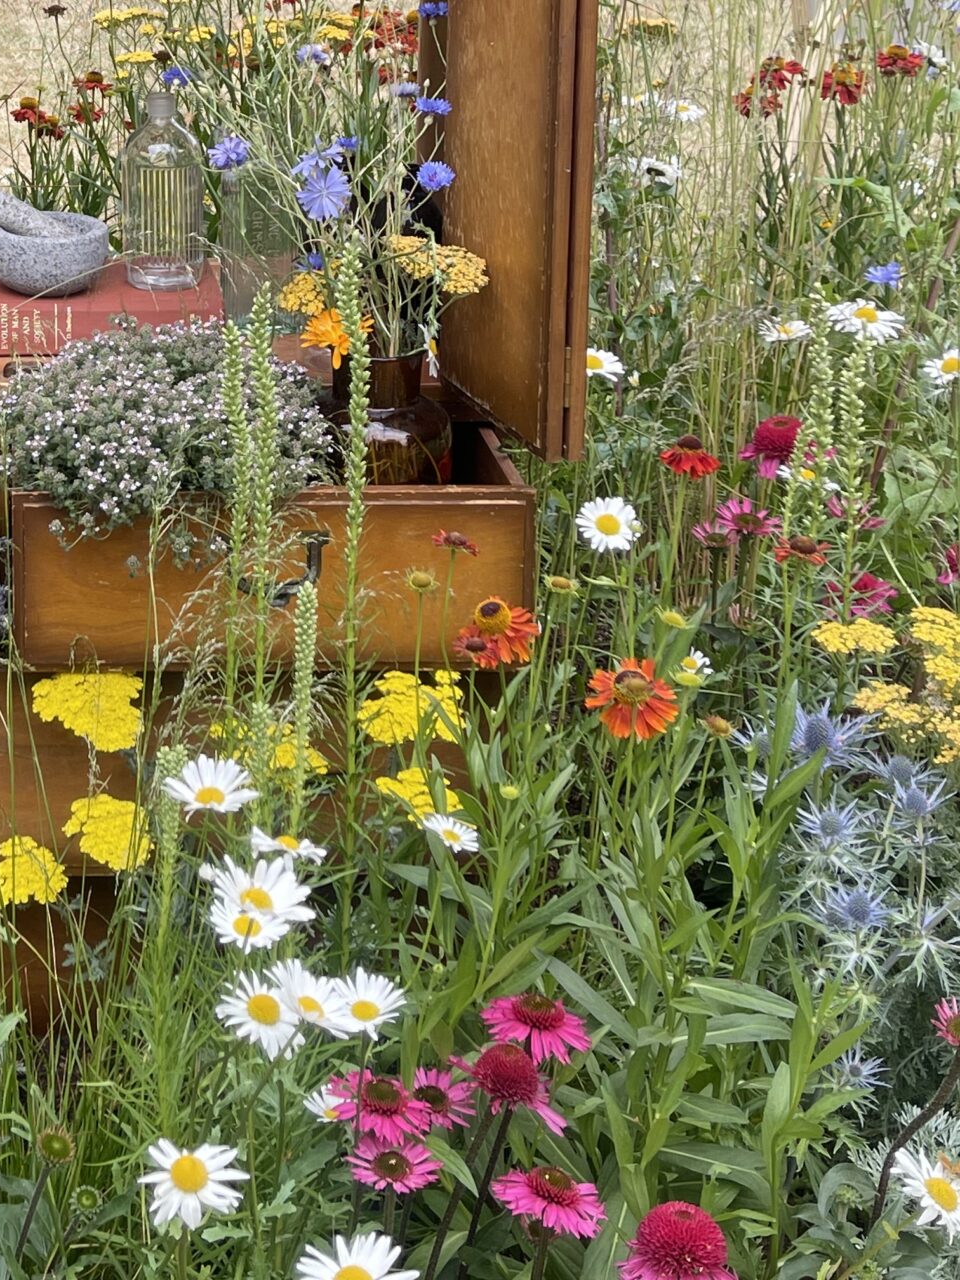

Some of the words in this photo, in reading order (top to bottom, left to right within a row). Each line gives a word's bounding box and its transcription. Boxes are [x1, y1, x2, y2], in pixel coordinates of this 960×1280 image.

[0, 303, 9, 350] EVOLUTION
[11, 308, 19, 329] MAN
[22, 316, 30, 335] AND
